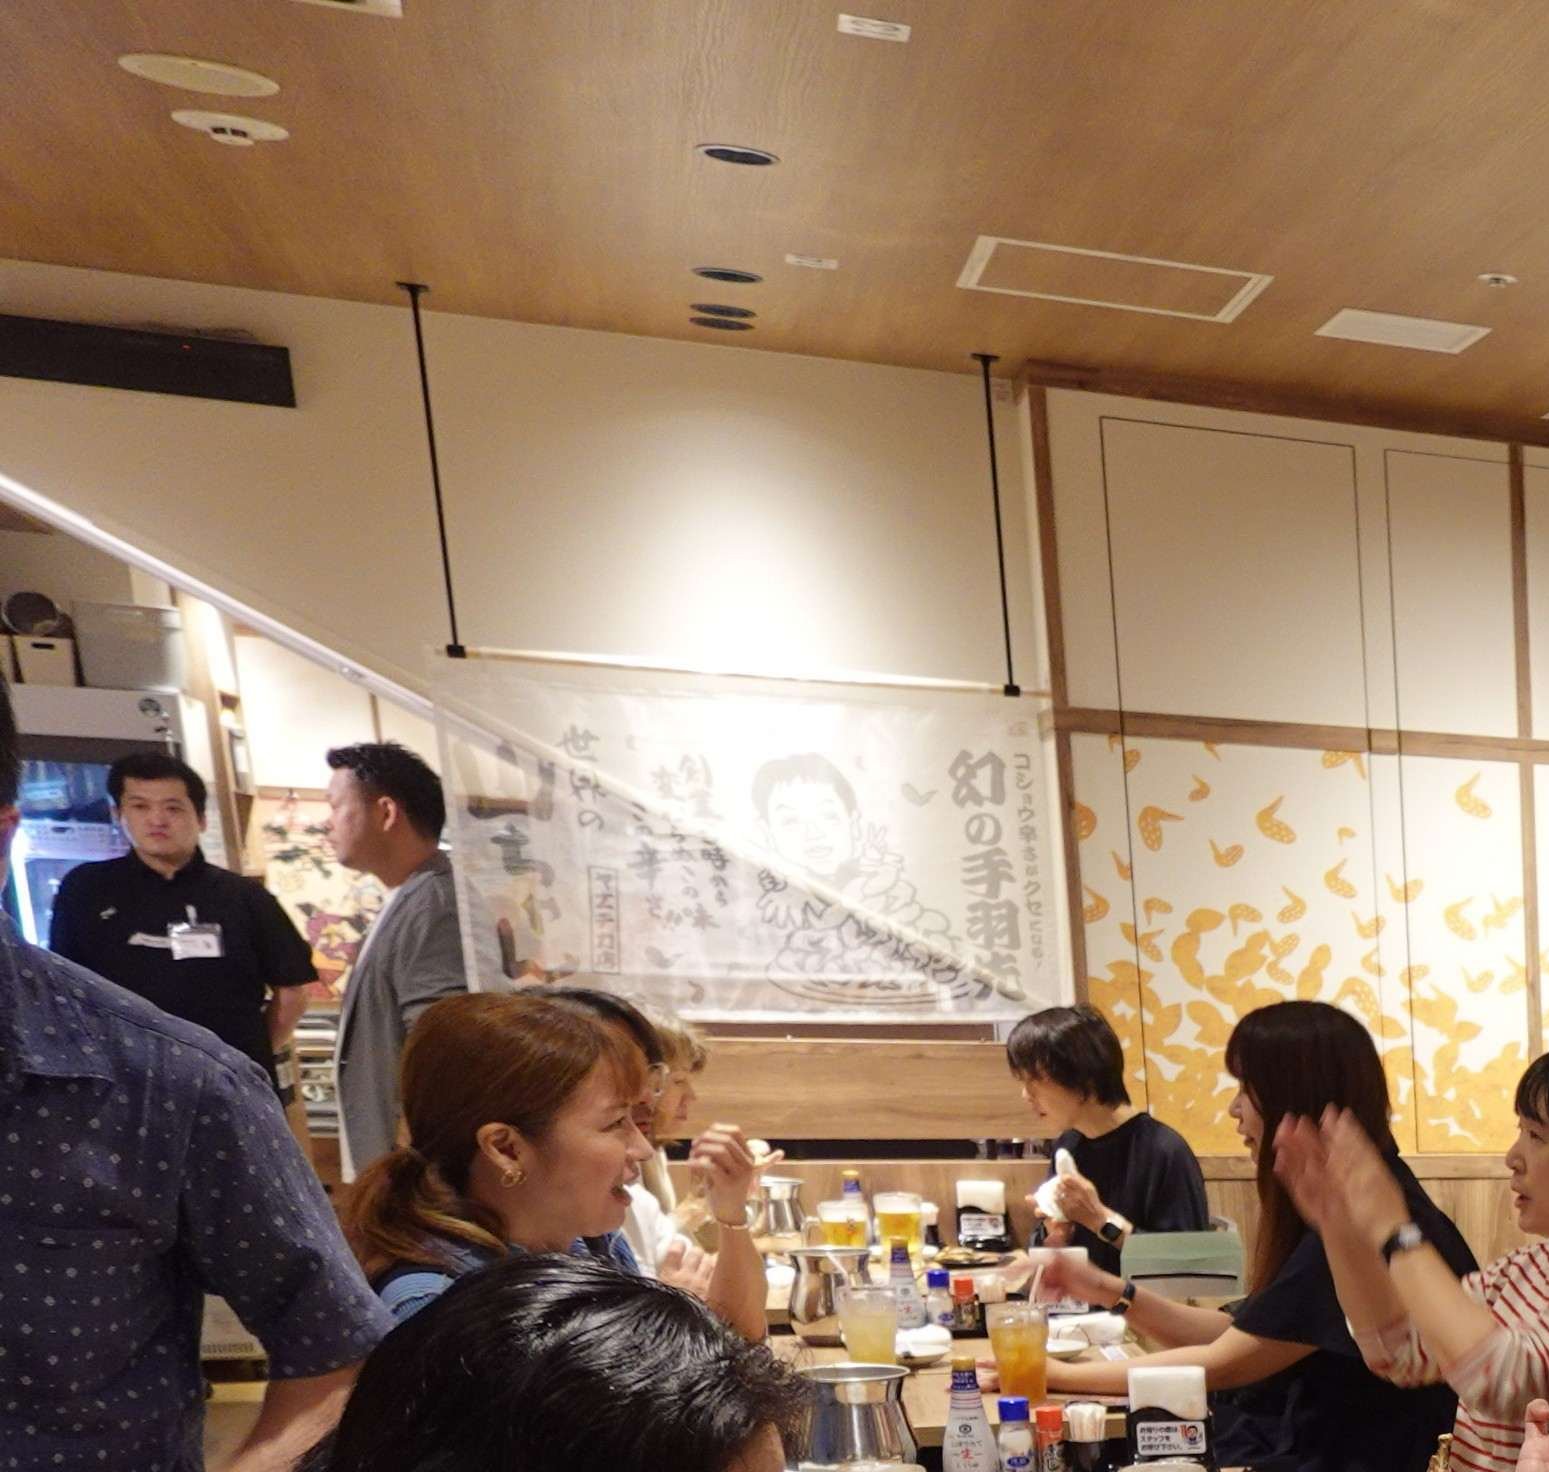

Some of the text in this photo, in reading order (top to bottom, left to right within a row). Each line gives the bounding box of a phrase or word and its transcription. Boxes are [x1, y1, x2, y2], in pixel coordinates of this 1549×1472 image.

[557, 725, 607, 831] 世界の
[948, 749, 1026, 1001] 幻の手羽先
